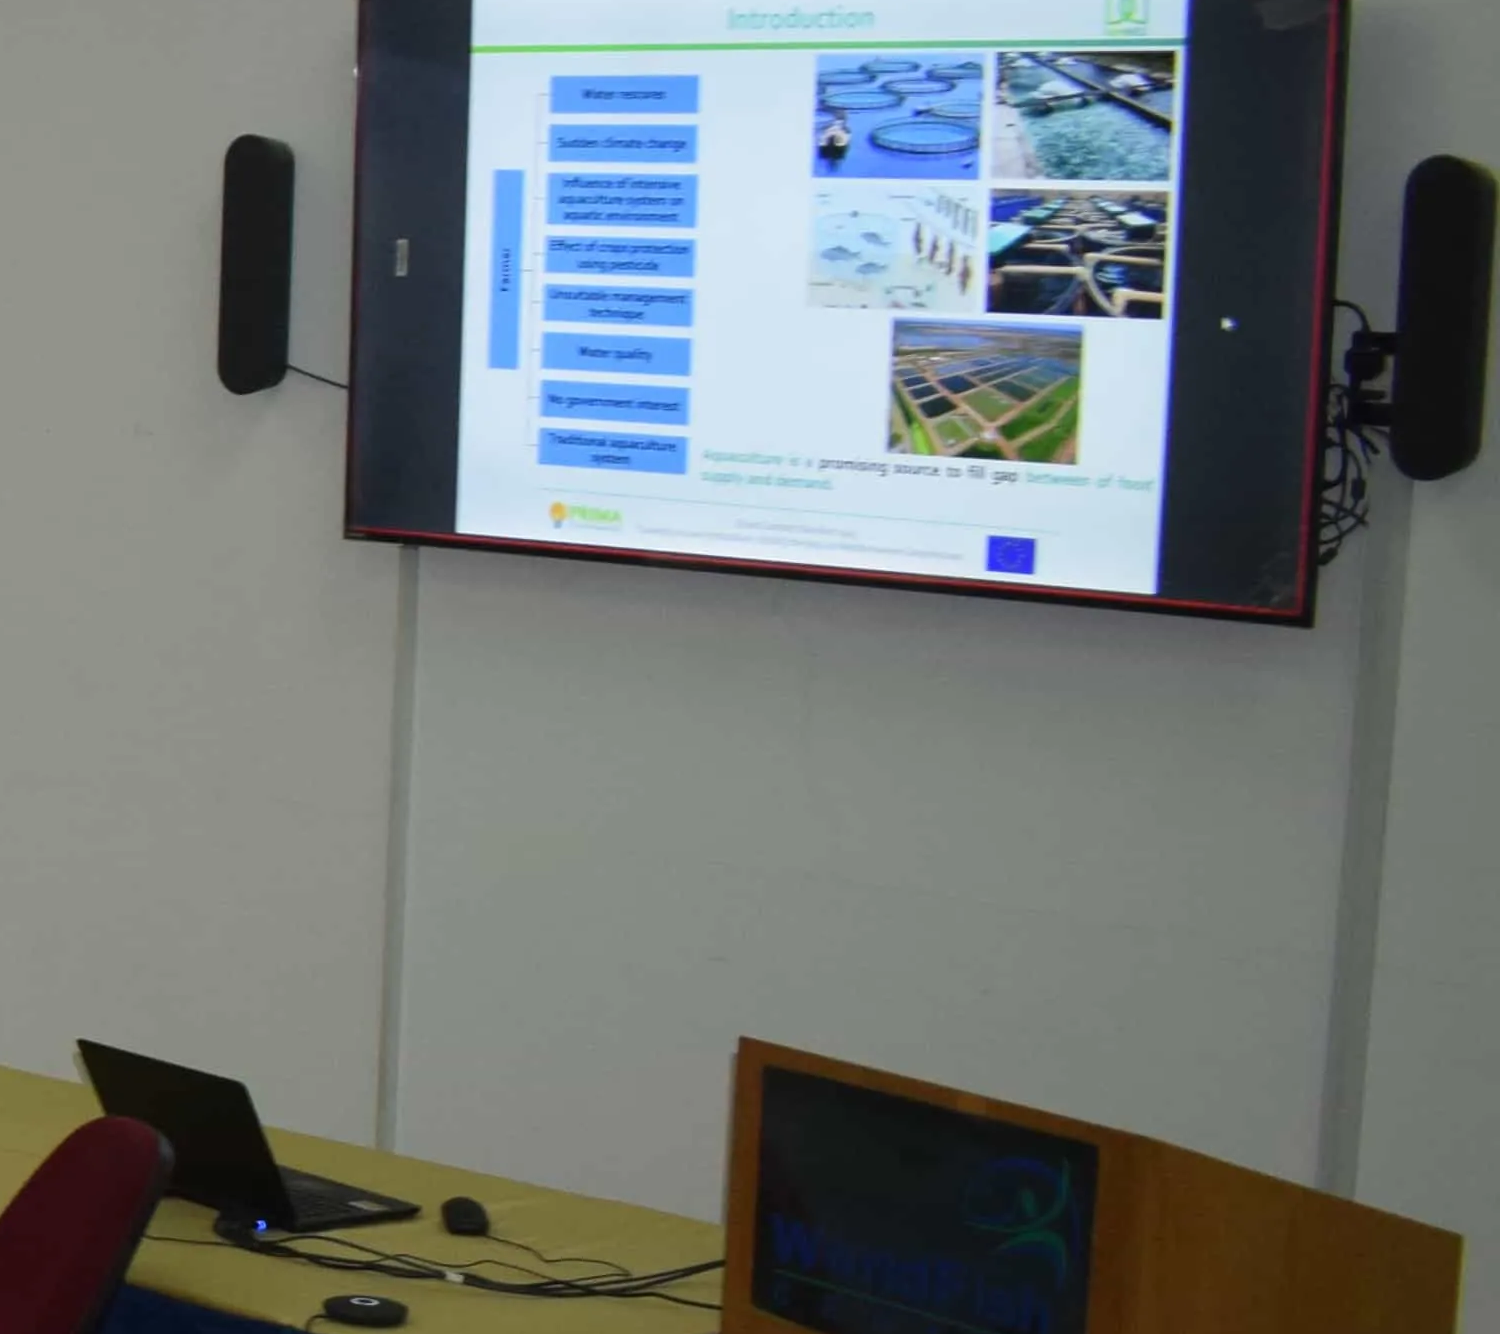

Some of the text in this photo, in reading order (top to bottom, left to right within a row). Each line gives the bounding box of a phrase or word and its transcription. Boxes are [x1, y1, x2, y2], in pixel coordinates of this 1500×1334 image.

[727, 4, 877, 30] Introduction
[818, 457, 888, 477] promising
[892, 463, 940, 478] source
[946, 463, 961, 478] to
[992, 469, 1019, 485] gap
